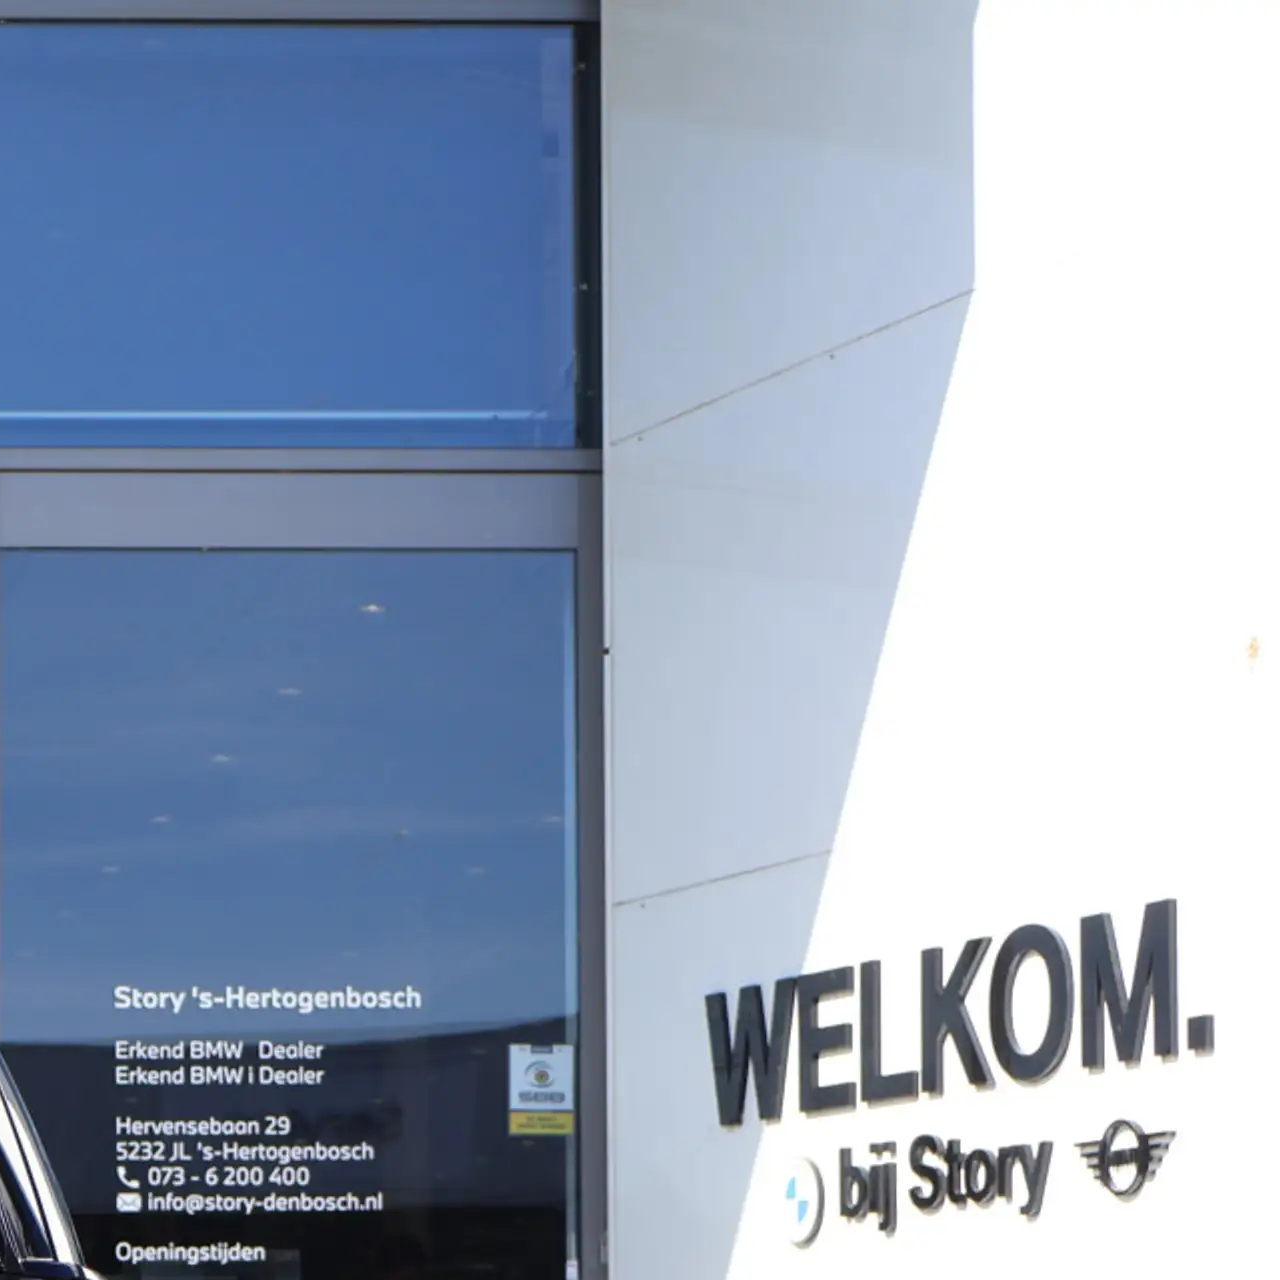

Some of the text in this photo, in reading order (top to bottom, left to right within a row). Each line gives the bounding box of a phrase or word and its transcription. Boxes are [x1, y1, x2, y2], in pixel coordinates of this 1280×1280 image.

[114, 986, 422, 1013] Story 's-Hertogenbosch
[704, 898, 1215, 1130] WELKOM.
[115, 1040, 324, 1059] Erkend BMW Dealer
[115, 1066, 325, 1085] Erkend BMW i Dealer
[115, 1116, 259, 1135] Hervensebaan
[264, 1116, 291, 1135] 29
[115, 1141, 374, 1164] 5232 JL 's-Hertogenbosch
[147, 1166, 186, 1186] 073
[204, 1166, 219, 1186] 6
[223, 1166, 263, 1186] 200
[268, 1166, 310, 1186] 400
[839, 1134, 1054, 1236] bij Story
[147, 1192, 383, 1215] info@story-denbosch.nl
[115, 1242, 266, 1264] Openingstijden
